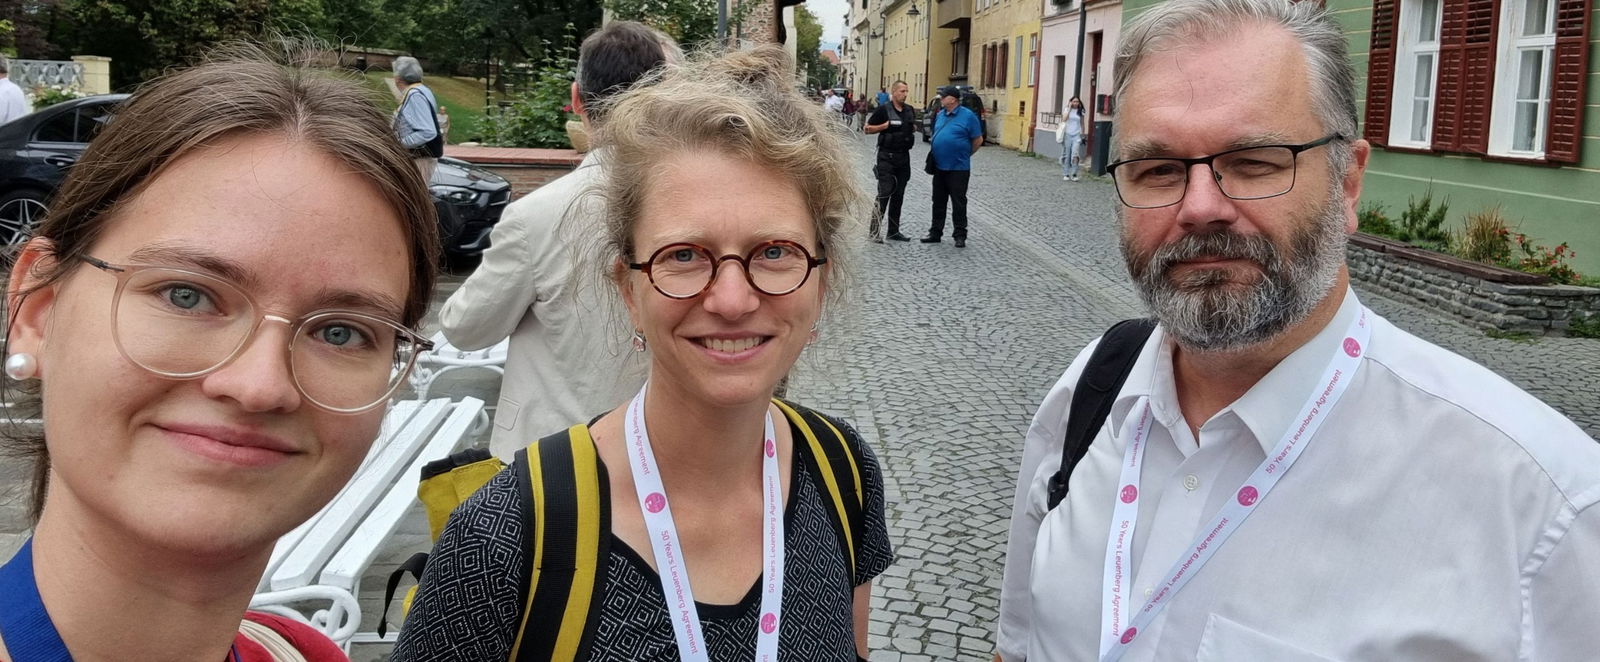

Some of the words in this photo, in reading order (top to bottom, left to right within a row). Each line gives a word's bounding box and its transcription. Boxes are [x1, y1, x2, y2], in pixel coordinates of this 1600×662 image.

[1265, 463, 1276, 474] 50
[1274, 446, 1292, 465] Years
[1289, 408, 1318, 446] Leuenberg
[1315, 369, 1342, 408] Agreement
[635, 435, 650, 475] Agreement
[661, 530, 670, 541] 50
[769, 516, 777, 558] Leuenberg
[1119, 529, 1128, 549] Years
[1121, 520, 1130, 529] 50
[664, 541, 675, 564] Years
[1112, 550, 1123, 593] Leuenberg
[1152, 586, 1170, 604] Years
[1167, 552, 1199, 586] Leuenberg
[1196, 517, 1229, 553] Agreement
[670, 565, 686, 609] Leuenberg
[769, 583, 775, 593] 50
[682, 610, 698, 655] Agreement
[1111, 594, 1121, 637] Agreement
